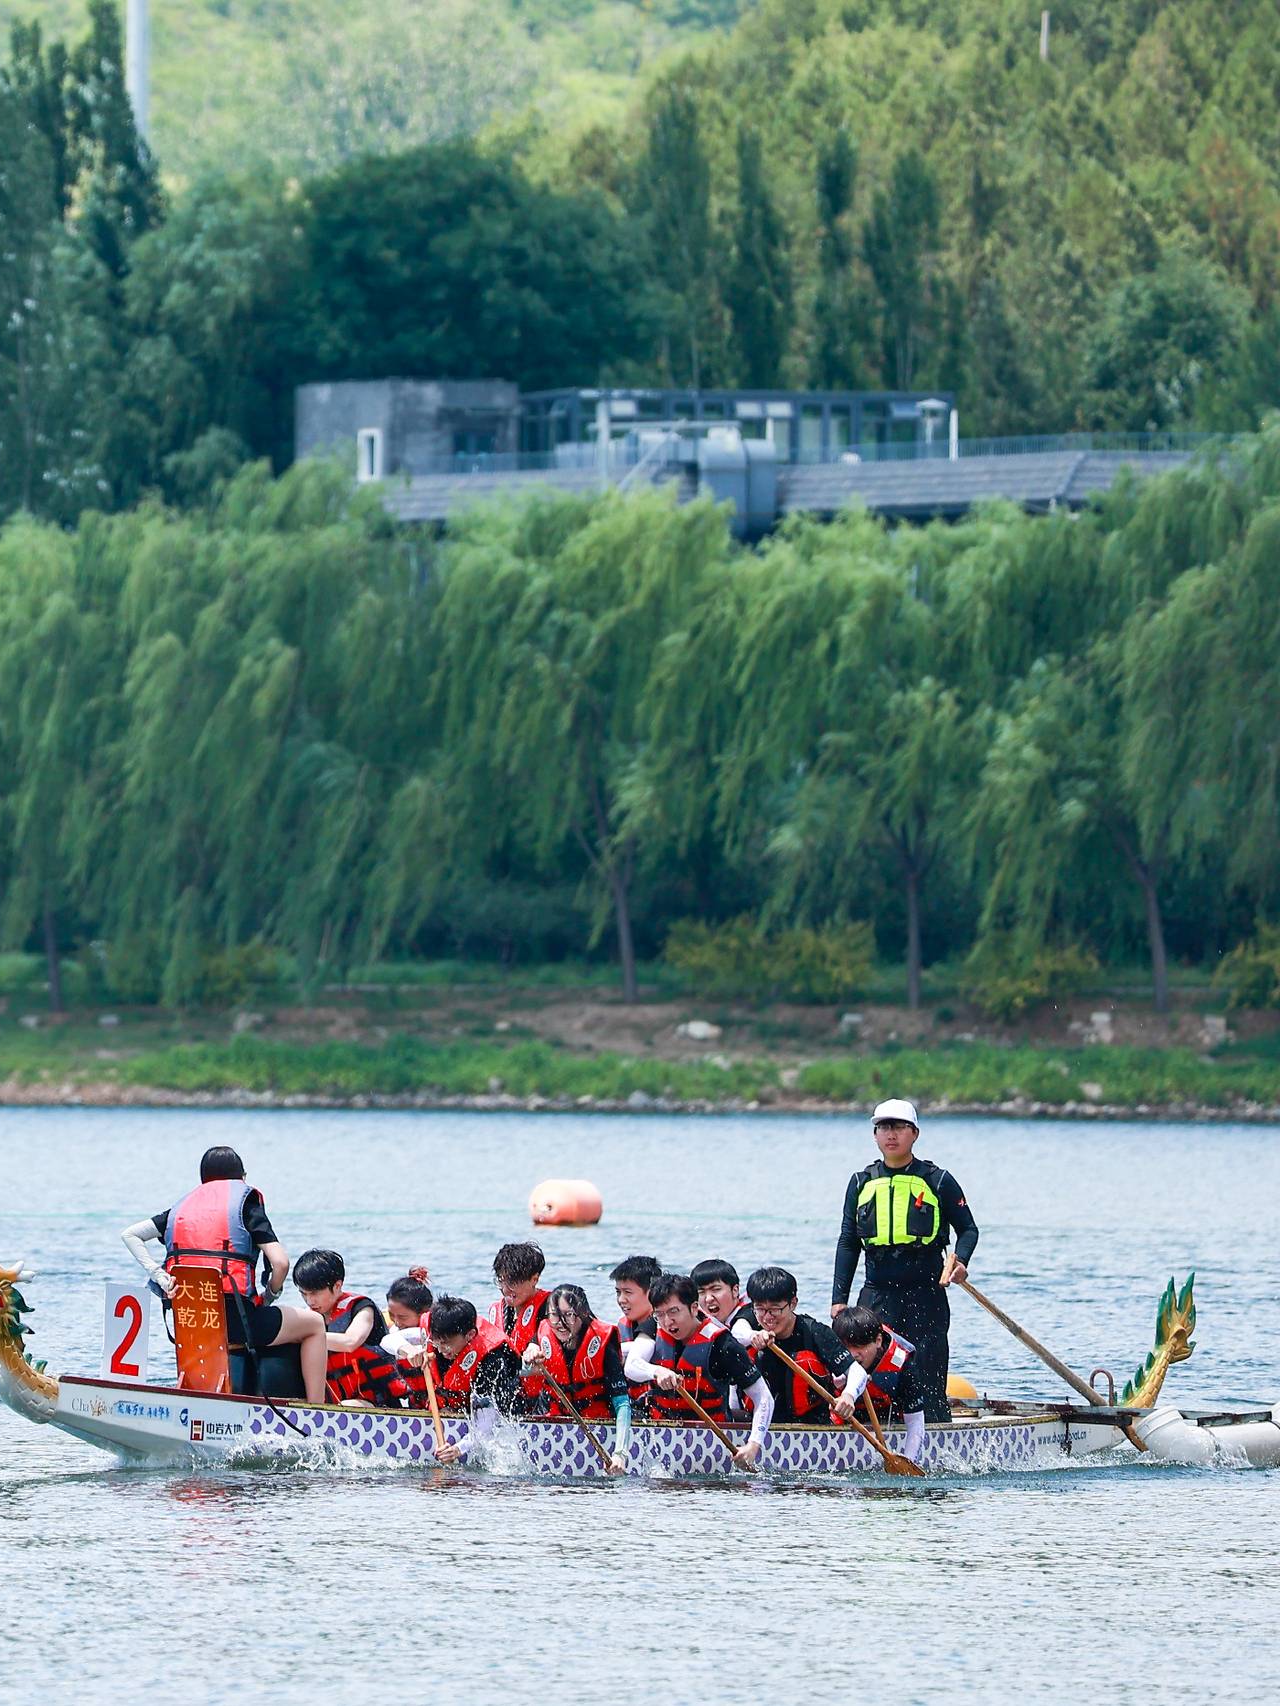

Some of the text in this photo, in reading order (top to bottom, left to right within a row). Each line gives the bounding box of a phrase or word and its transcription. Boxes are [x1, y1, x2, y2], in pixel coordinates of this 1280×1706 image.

[176, 1279, 219, 1303] 大连
[177, 1306, 221, 1330] 乾龙
[110, 1294, 143, 1377] 2
